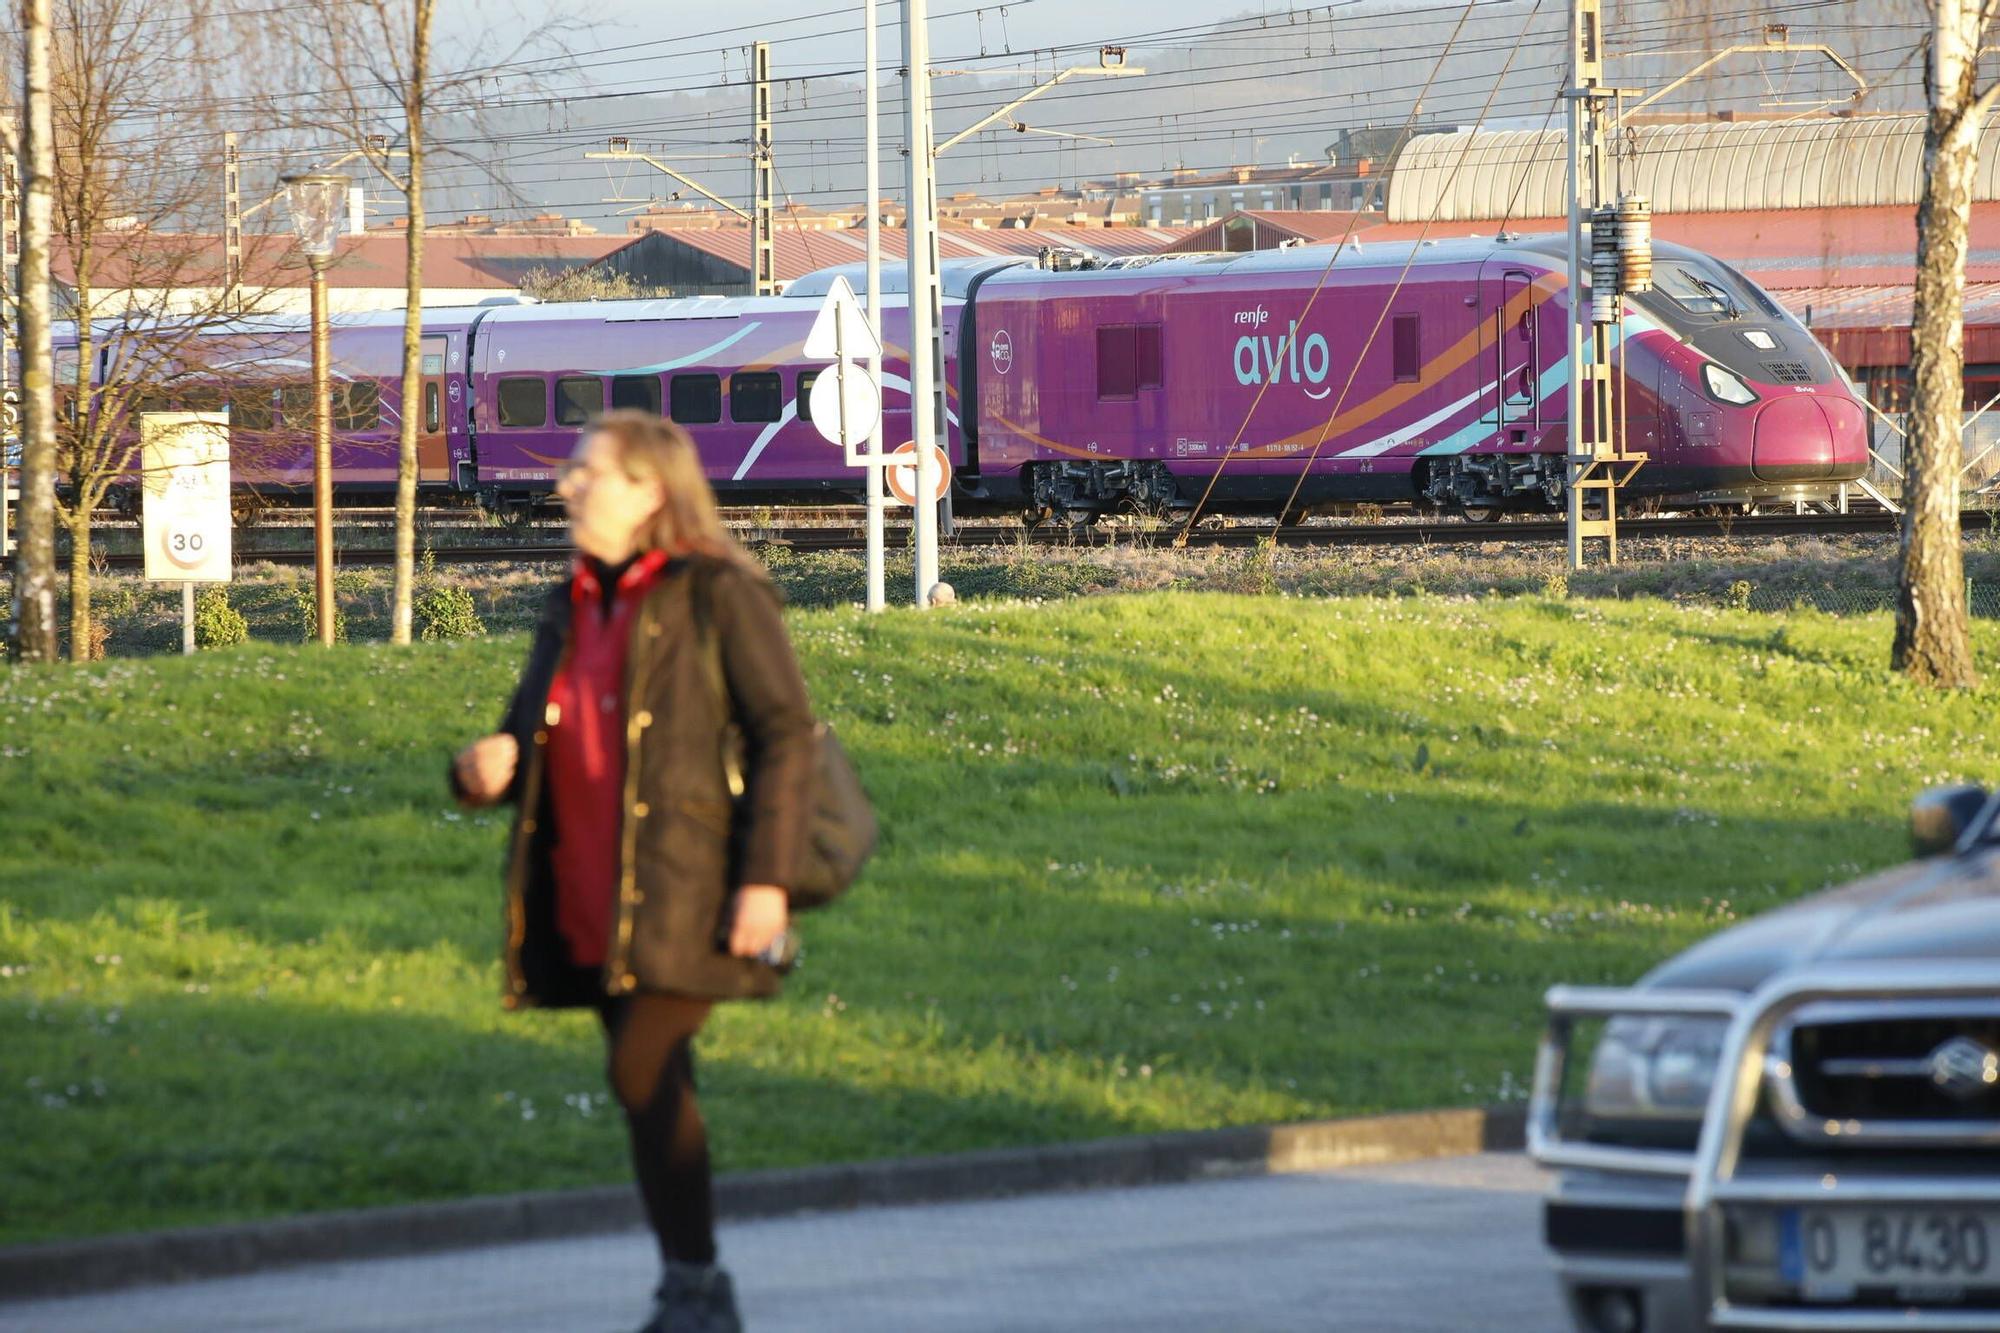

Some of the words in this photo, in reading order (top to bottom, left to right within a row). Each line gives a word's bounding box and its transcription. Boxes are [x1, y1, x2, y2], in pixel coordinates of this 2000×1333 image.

[1234, 304, 1269, 329] renfe
[1233, 320, 1330, 386] avlo
[172, 533, 203, 551] 30
[1862, 1213, 1989, 1275] 8430
